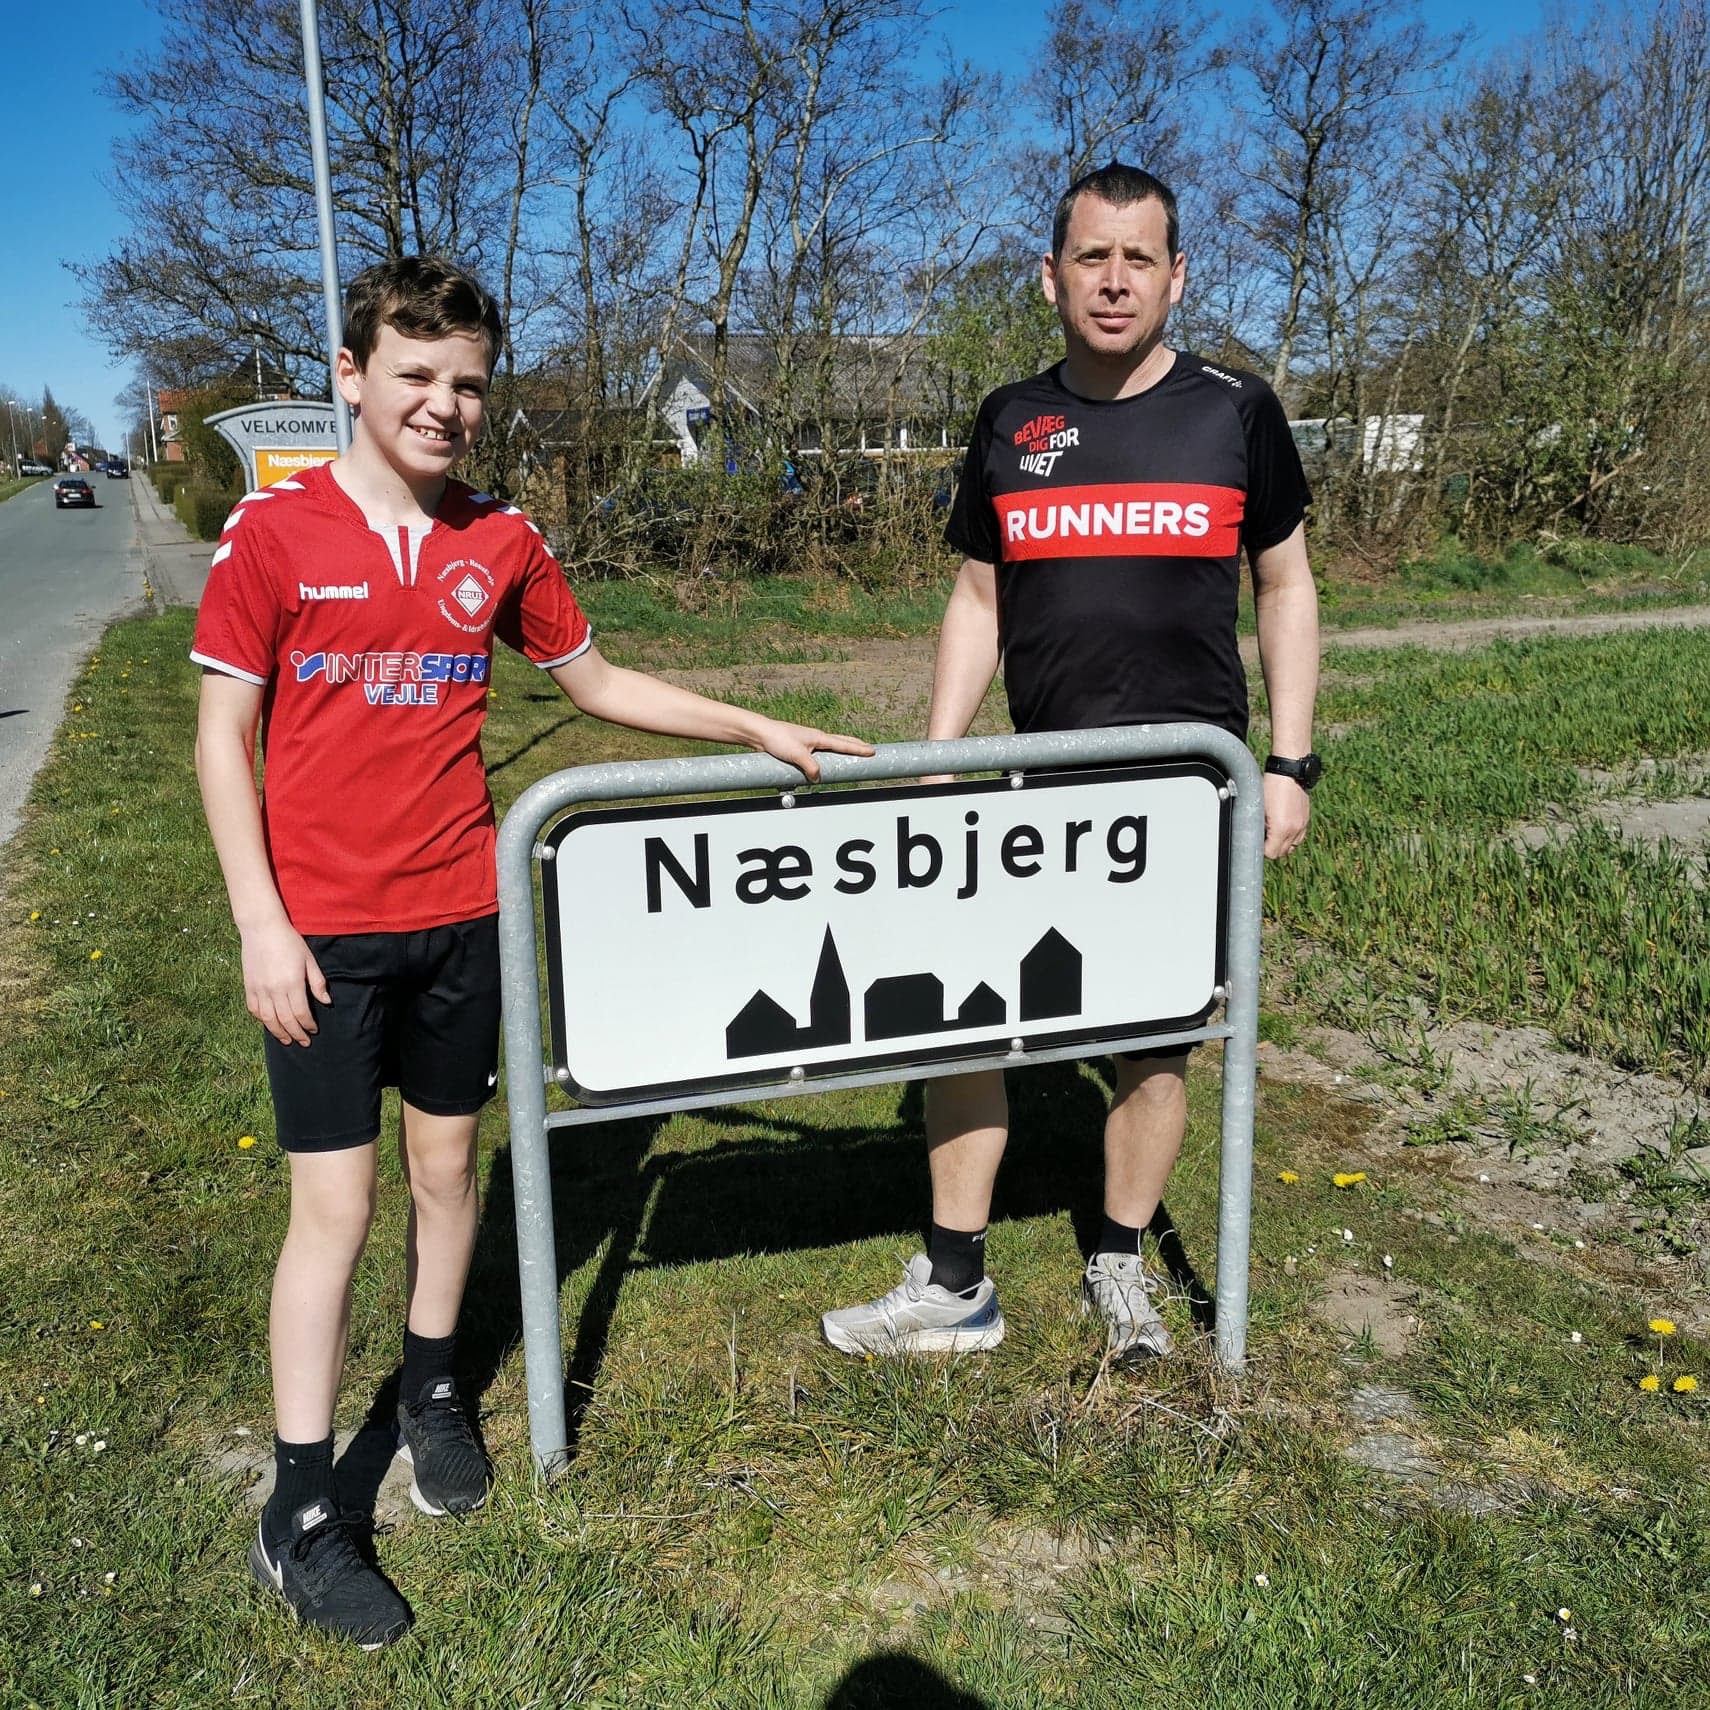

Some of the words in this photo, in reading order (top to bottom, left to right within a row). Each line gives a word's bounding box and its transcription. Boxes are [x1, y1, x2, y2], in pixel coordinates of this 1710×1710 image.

[1201, 366, 1237, 383] CRAFT
[241, 419, 337, 434] VELKOMME
[1014, 415, 1065, 446] BEVÆG
[1029, 437, 1049, 453] DIG
[1049, 427, 1080, 450] FOR
[1019, 450, 1064, 477] LIVET
[1006, 501, 1210, 543] RUNNERS
[299, 581, 369, 600] hummel
[326, 651, 489, 684] INTERSPOR
[364, 683, 438, 705] VEJLE
[644, 810, 1148, 913] Næsbjerg
